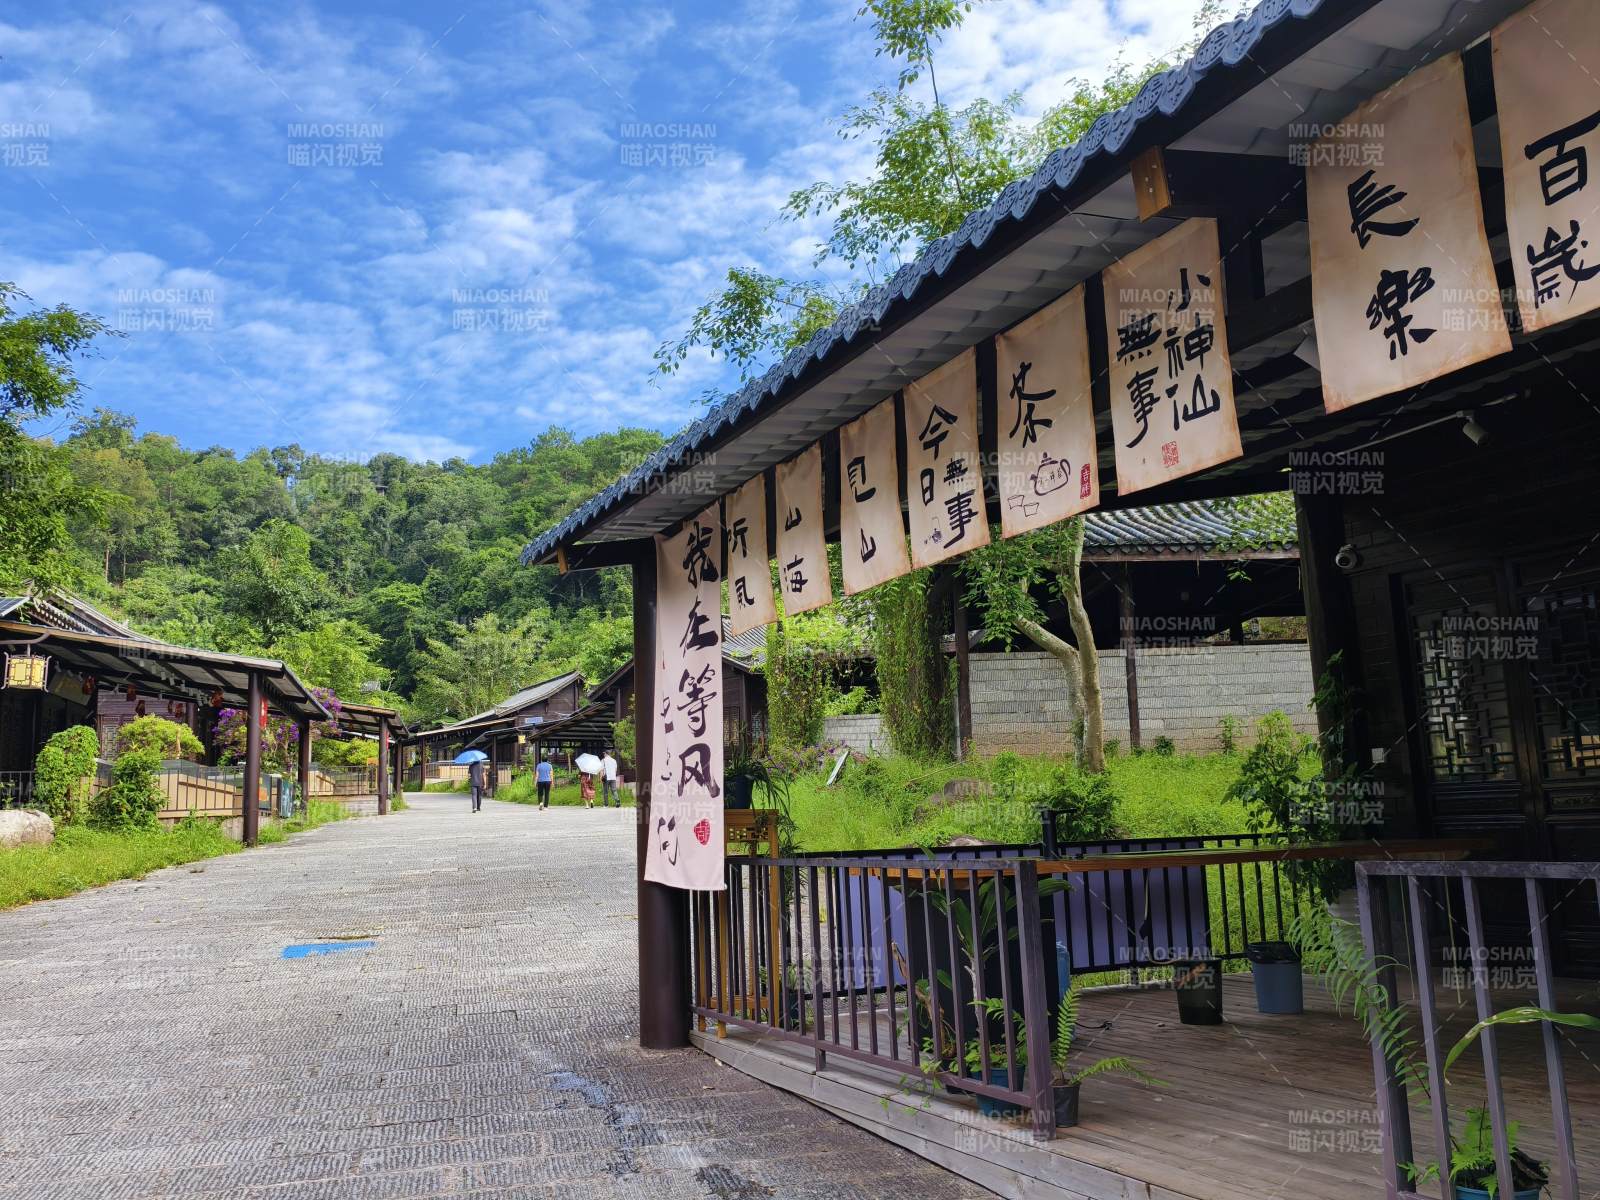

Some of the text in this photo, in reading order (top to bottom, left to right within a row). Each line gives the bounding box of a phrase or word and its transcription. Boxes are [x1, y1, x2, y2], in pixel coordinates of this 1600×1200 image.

[1116, 313, 1159, 448] 無事
[1162, 267, 1221, 431] 小神仙
[918, 404, 957, 507] 今日
[1009, 360, 1057, 449] 茶
[783, 505, 809, 593] 山海
[944, 457, 979, 549] 無事
[677, 520, 721, 798] 我在等风
